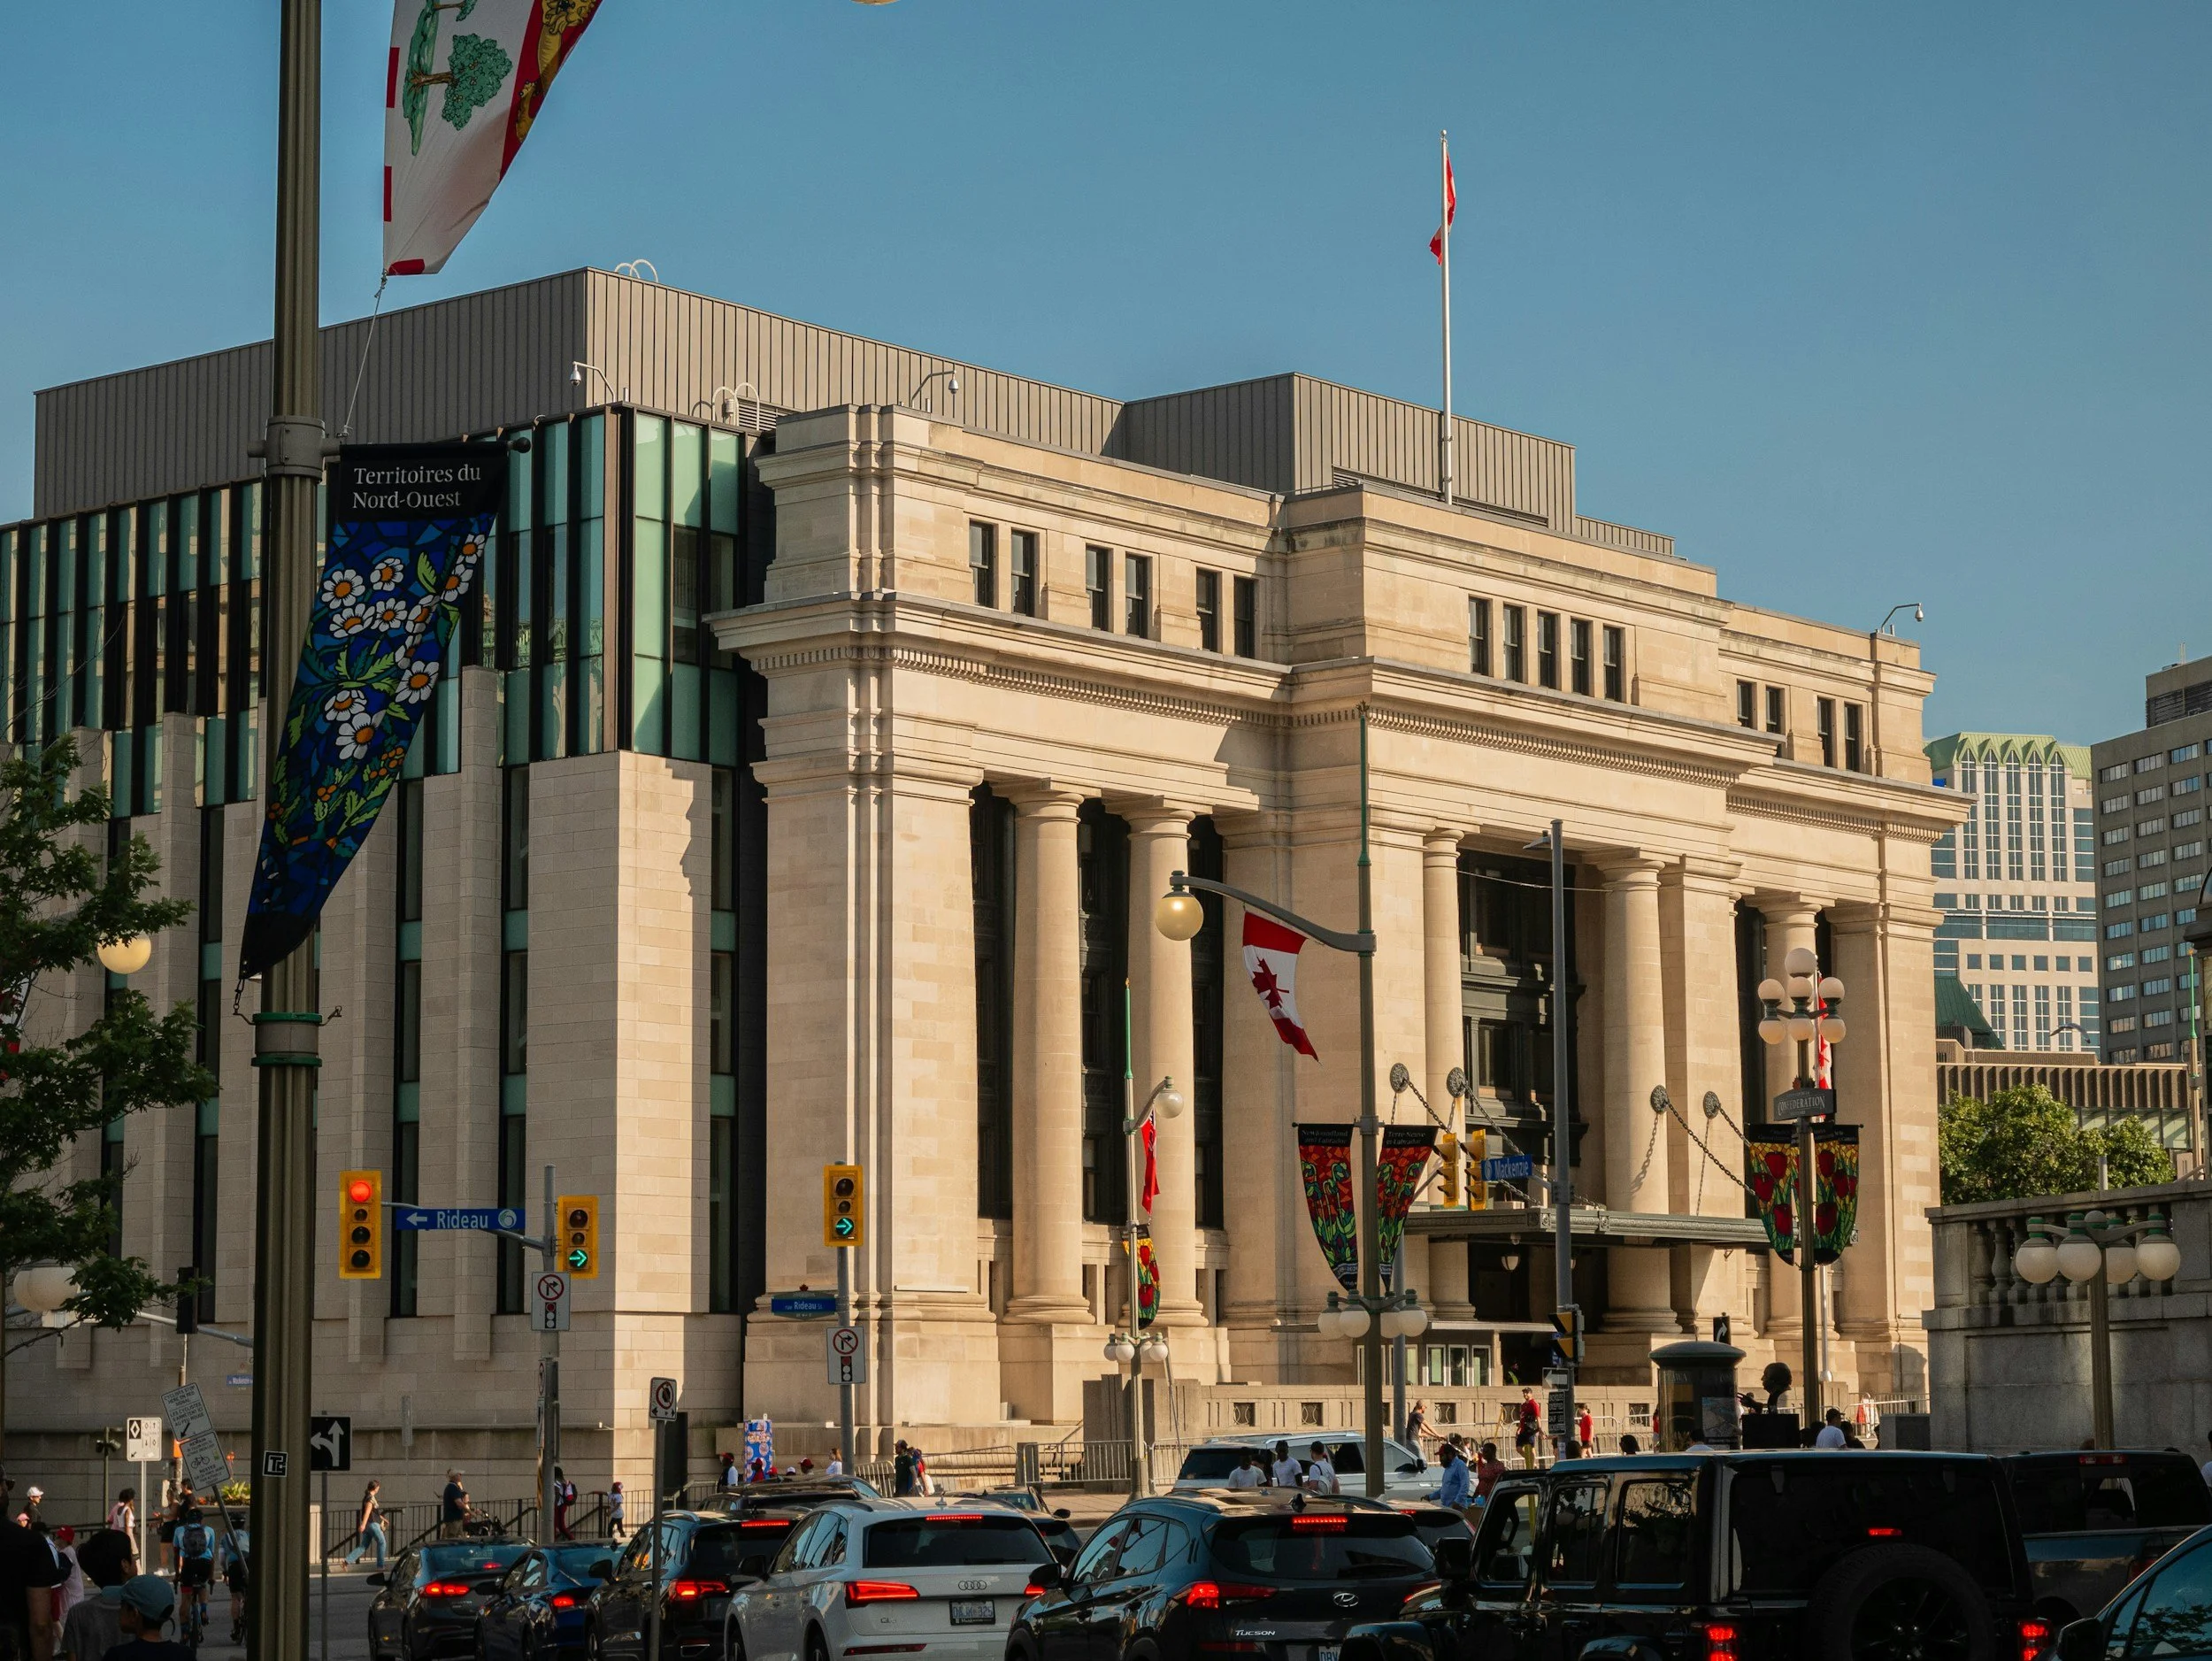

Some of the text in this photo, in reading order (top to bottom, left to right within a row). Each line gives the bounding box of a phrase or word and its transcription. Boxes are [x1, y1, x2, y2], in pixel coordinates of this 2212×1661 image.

[354, 464, 481, 484] Territoires du
[352, 490, 462, 509] Nord-Ouest
[1494, 1157, 1530, 1179] Mackenzie
[437, 1210, 488, 1229] Rideau
[794, 1301, 817, 1310] Rideau
